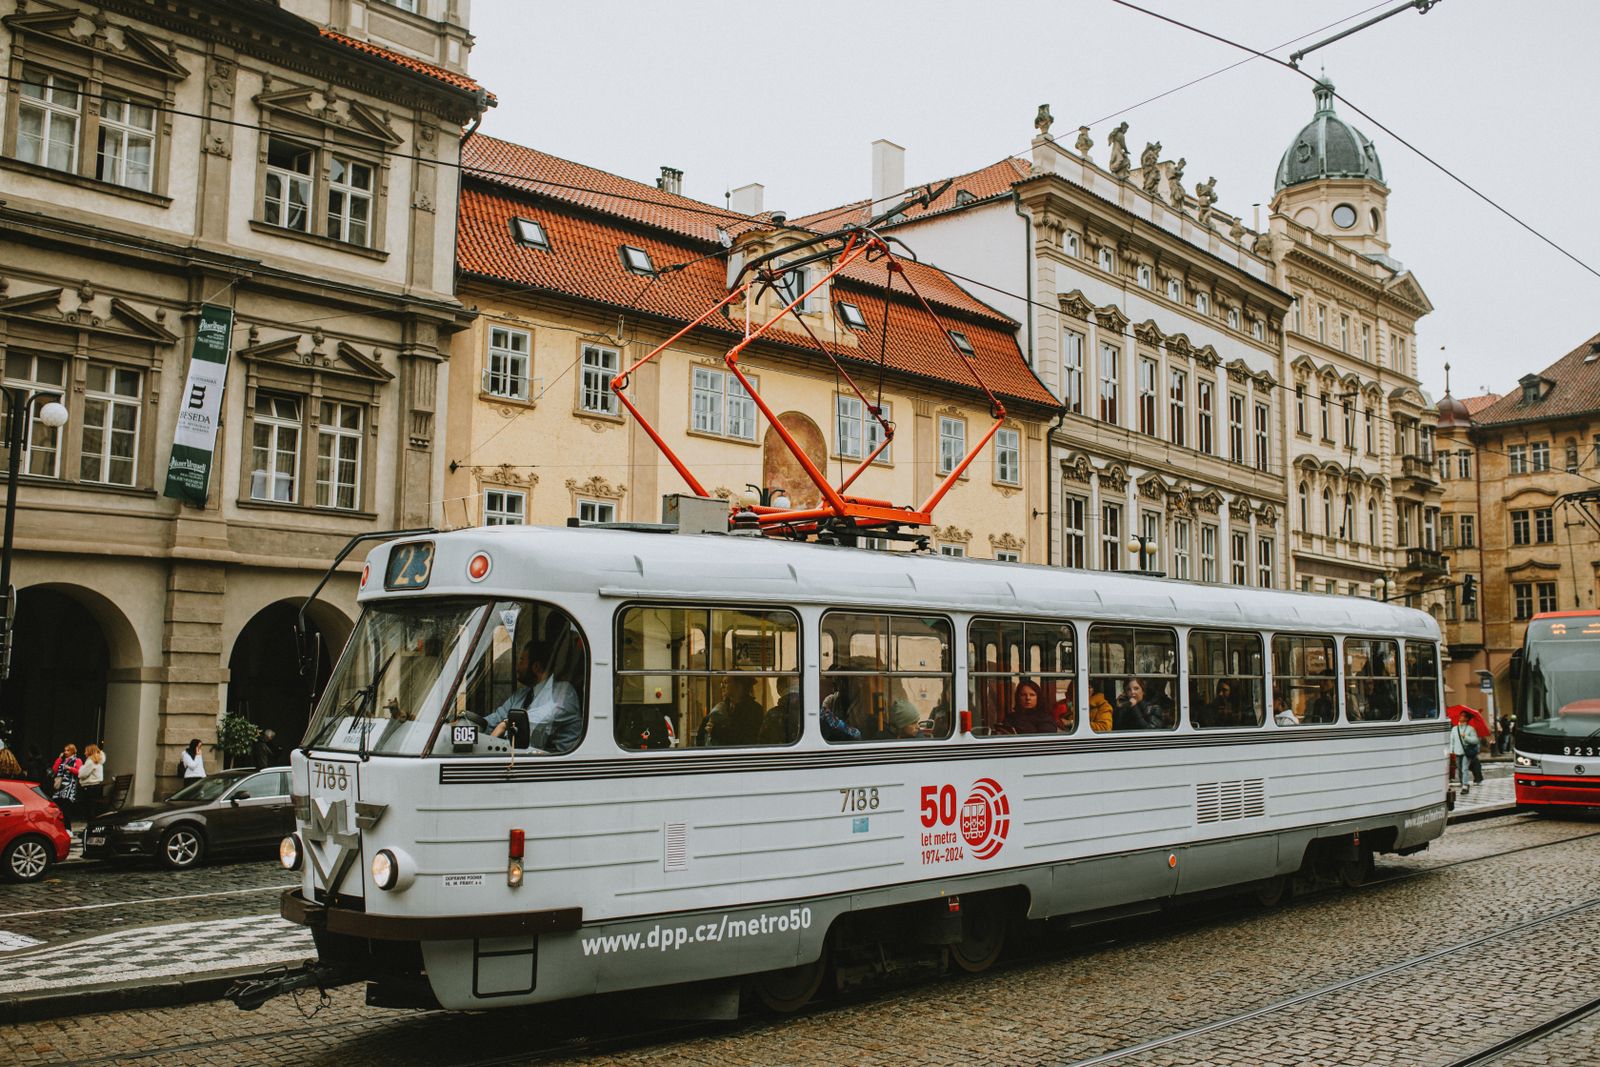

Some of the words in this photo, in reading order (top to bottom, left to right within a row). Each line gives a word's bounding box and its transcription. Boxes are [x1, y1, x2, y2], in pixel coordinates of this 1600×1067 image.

[394, 543, 433, 584] 23
[454, 726, 475, 741] 605
[314, 762, 348, 791] 7188
[840, 787, 880, 813] 7188
[920, 784, 957, 828] 50
[921, 832, 932, 846] let
[934, 831, 957, 845] metra
[582, 907, 811, 956] www.dpp.cz/metro50
